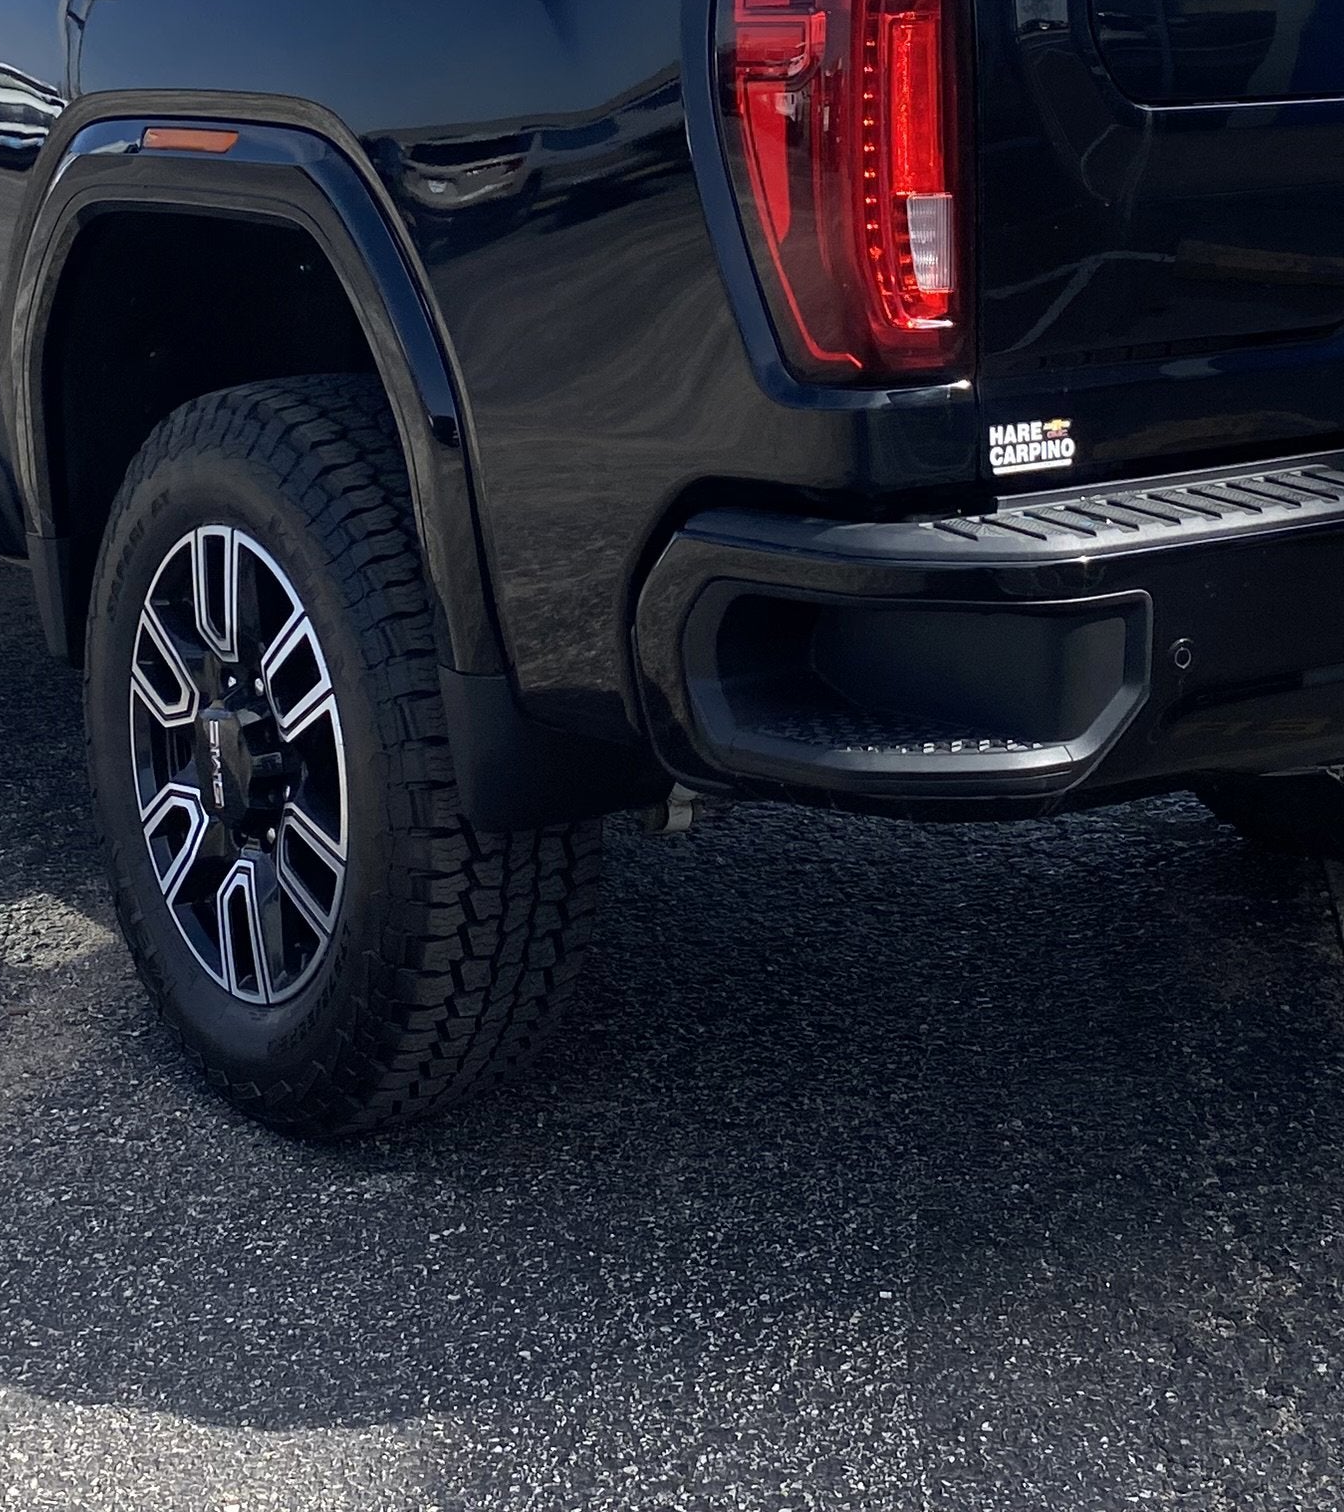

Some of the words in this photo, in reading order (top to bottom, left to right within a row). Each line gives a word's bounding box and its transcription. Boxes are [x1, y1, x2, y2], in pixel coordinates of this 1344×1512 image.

[989, 420, 1043, 446] HARE
[989, 437, 1075, 466] CARPINO
[209, 720, 224, 808] GMC
